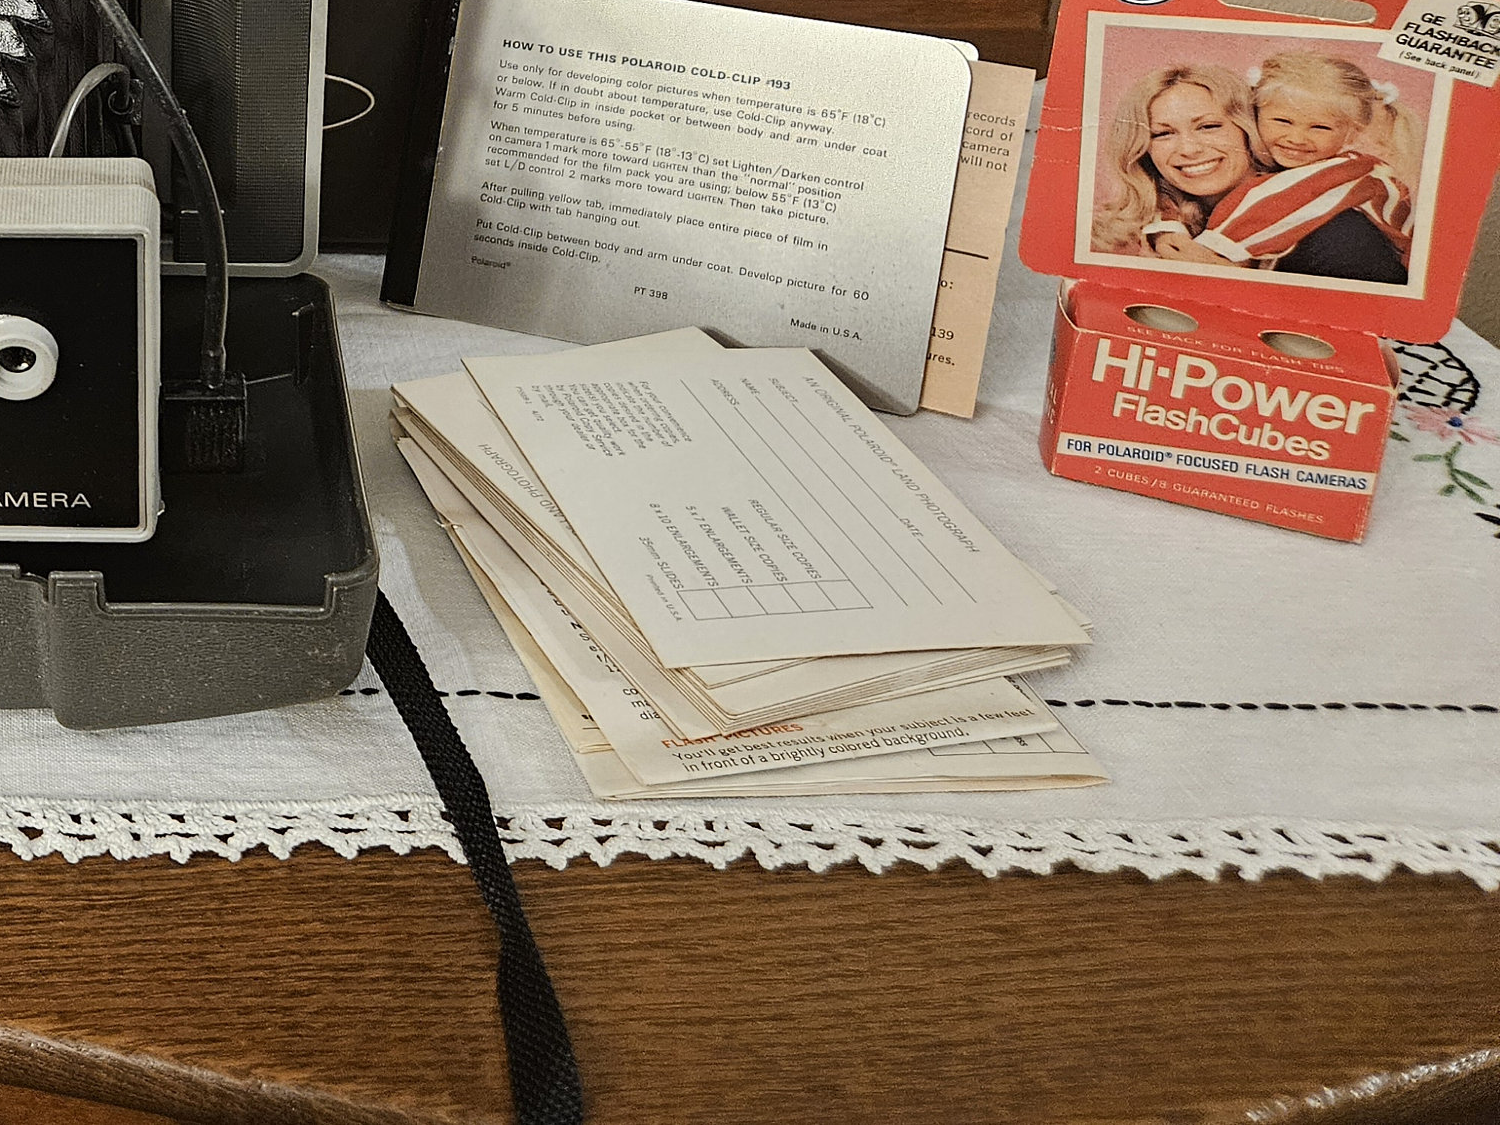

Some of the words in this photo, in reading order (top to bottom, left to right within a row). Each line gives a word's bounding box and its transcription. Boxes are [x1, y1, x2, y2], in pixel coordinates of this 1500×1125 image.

[1403, 22, 1500, 55] FLASHBACK
[1421, 12, 1446, 26] GE
[502, 39, 534, 51] HOW
[538, 44, 554, 55] TO
[558, 47, 583, 59] USE
[587, 51, 617, 63] THIS
[621, 56, 686, 74] POLAROID
[691, 66, 761, 85] COLD-CLIP
[1396, 34, 1498, 69] GUARANTEE
[1399, 51, 1421, 62] (See
[1425, 58, 1446, 70] back
[1449, 65, 1481, 79] panel)
[496, 74, 508, 83] or
[511, 76, 545, 89] below.
[549, 80, 558, 90] If
[560, 82, 570, 92] in
[573, 84, 604, 98] doubt
[607, 90, 638, 103] about
[641, 95, 709, 116] temperature,
[713, 107, 732, 118] use
[736, 109, 786, 128] Cold-Clip
[790, 120, 835, 136] anyway.
[499, 59, 519, 71] Use
[522, 63, 545, 76] only
[548, 66, 563, 77] for
[566, 68, 623, 88] developing
[626, 78, 653, 91] color
[656, 84, 699, 98] pictures
[702, 91, 732, 103] when
[736, 96, 803, 115] temperature
[806, 106, 817, 117] is
[821, 108, 849, 121] 65°F
[852, 113, 887, 129] (18°C)
[967, 111, 1016, 128] records
[1000, 131, 1013, 143] of
[960, 155, 983, 167] will
[986, 160, 1008, 172] not
[962, 140, 1010, 158] camera
[480, 193, 526, 210] Cold-Clip
[529, 202, 551, 214] with
[556, 206, 572, 217] tab
[576, 210, 617, 228] hanging
[621, 220, 641, 229] out.
[473, 233, 514, 248] seconds
[518, 239, 548, 253] inside
[552, 246, 601, 264] Cold-Clip.
[634, 285, 647, 296] PT
[648, 289, 669, 301] 398
[790, 318, 817, 331] Made
[819, 326, 829, 335] in
[832, 327, 863, 341] U.S.A.
[1127, 326, 1153, 336] SEE
[1162, 333, 1202, 345] BACK
[1212, 342, 1242, 354] FOR
[1251, 350, 1301, 365] FLASH
[1312, 362, 1344, 373] TIPS
[1112, 391, 1330, 461] FlashCubes
[478, 443, 543, 499] PHOTOGRAPH
[815, 387, 852, 423] ORIGINAL
[891, 467, 921, 492] LAND
[916, 493, 980, 554] PHOTOGRAPH
[1067, 438, 1092, 452] FOR
[1176, 454, 1239, 473] FOCUSED
[1245, 463, 1290, 480] FLASH
[1296, 470, 1368, 490] CAMERAS
[1094, 465, 1102, 474] 2
[1173, 483, 1260, 509] GUARANTEED
[1265, 504, 1324, 524] FLASHES
[721, 506, 749, 535] WALLET
[744, 535, 765, 553] SIZE
[758, 553, 788, 582] COPIES
[748, 499, 782, 533] REGULAR
[777, 533, 798, 551] SIZE
[792, 551, 822, 580] COPIES
[900, 517, 924, 538] DATE
[672, 748, 715, 761] You'll
[719, 745, 740, 757] get
[742, 740, 775, 752] best
[776, 734, 821, 748] results
[824, 729, 862, 742] when
[865, 725, 896, 738] your
[900, 717, 952, 732] subject
[954, 713, 967, 723] is
[978, 711, 1002, 721] few
[1005, 709, 1036, 718] feet
[682, 761, 700, 773] in
[701, 757, 739, 772] front
[742, 753, 758, 765] of
[759, 756, 769, 764] a
[769, 746, 825, 763] brightly
[828, 736, 880, 754] colored
[884, 727, 969, 748] background.
